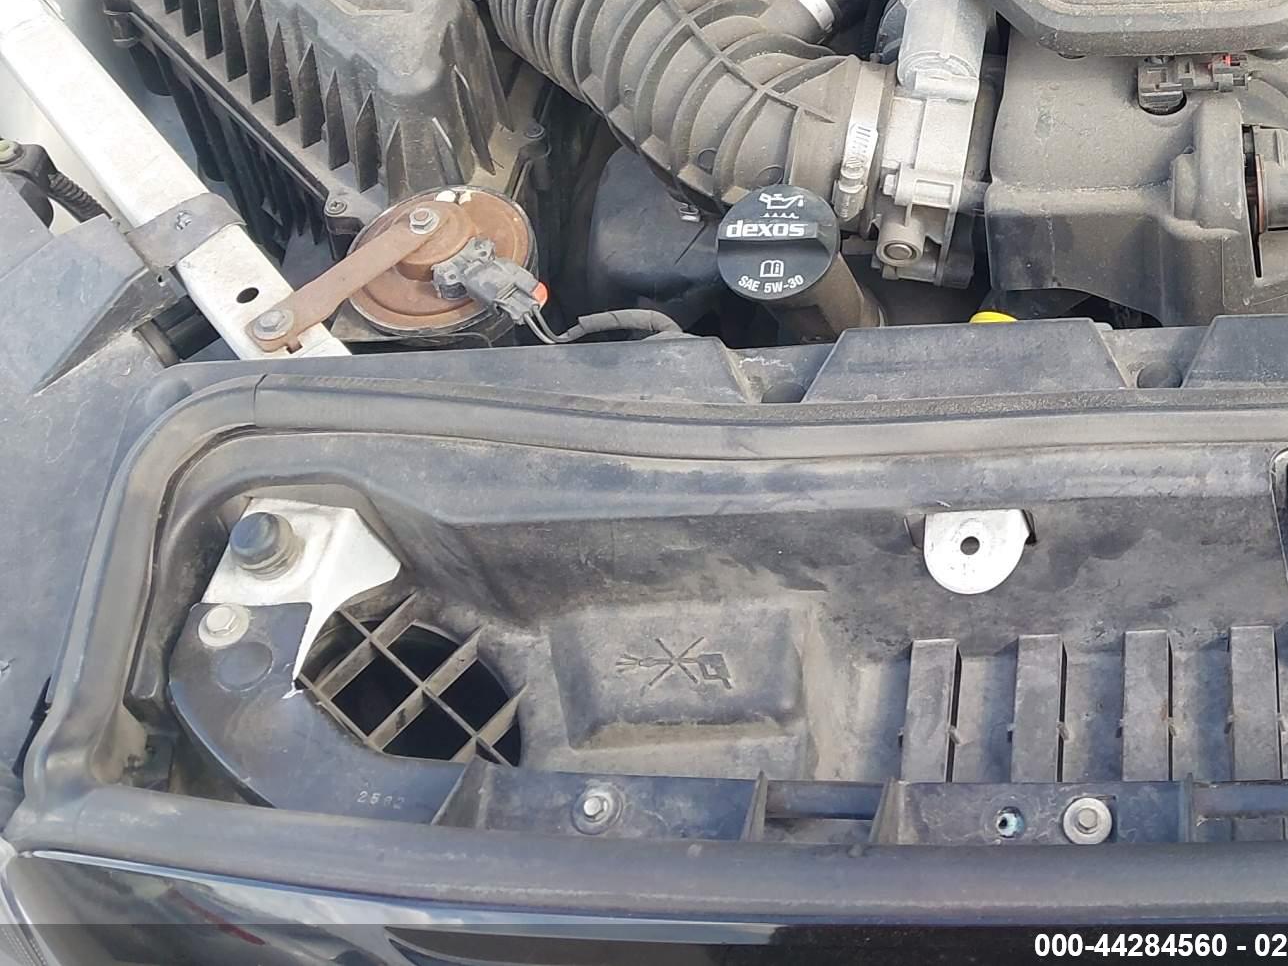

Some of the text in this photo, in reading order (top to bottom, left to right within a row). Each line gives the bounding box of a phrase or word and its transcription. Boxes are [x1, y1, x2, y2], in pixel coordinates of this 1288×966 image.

[726, 220, 809, 238] dexos
[738, 274, 804, 294] SAE 5W-30
